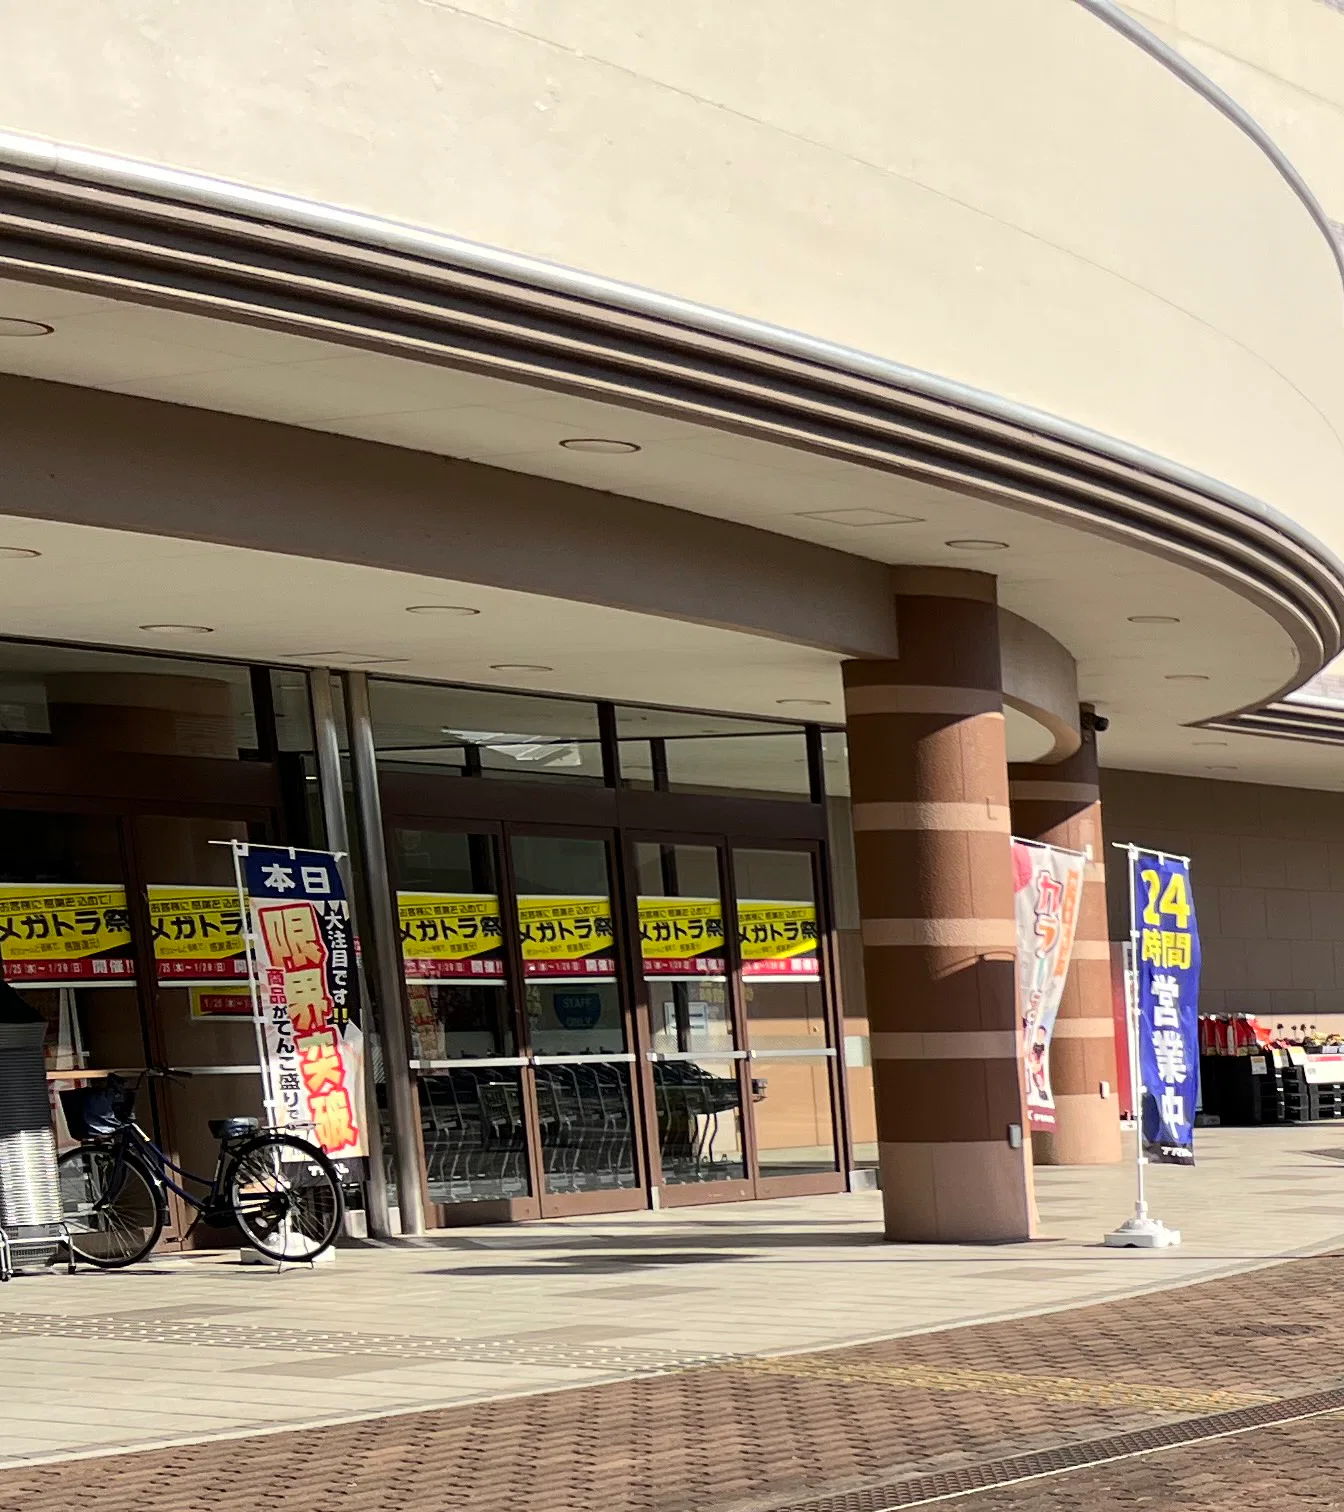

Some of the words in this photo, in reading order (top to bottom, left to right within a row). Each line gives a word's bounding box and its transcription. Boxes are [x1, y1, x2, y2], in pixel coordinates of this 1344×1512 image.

[261, 864, 330, 893] 本日
[1141, 869, 1191, 928] 24
[0, 909, 130, 941] メガトラ祭
[151, 912, 252, 940] メガトラ
[1141, 928, 1192, 970] 時間
[324, 911, 350, 1024] 大注目です!!
[260, 905, 357, 1151] 限界突破
[1151, 975, 1187, 1139] 営業中
